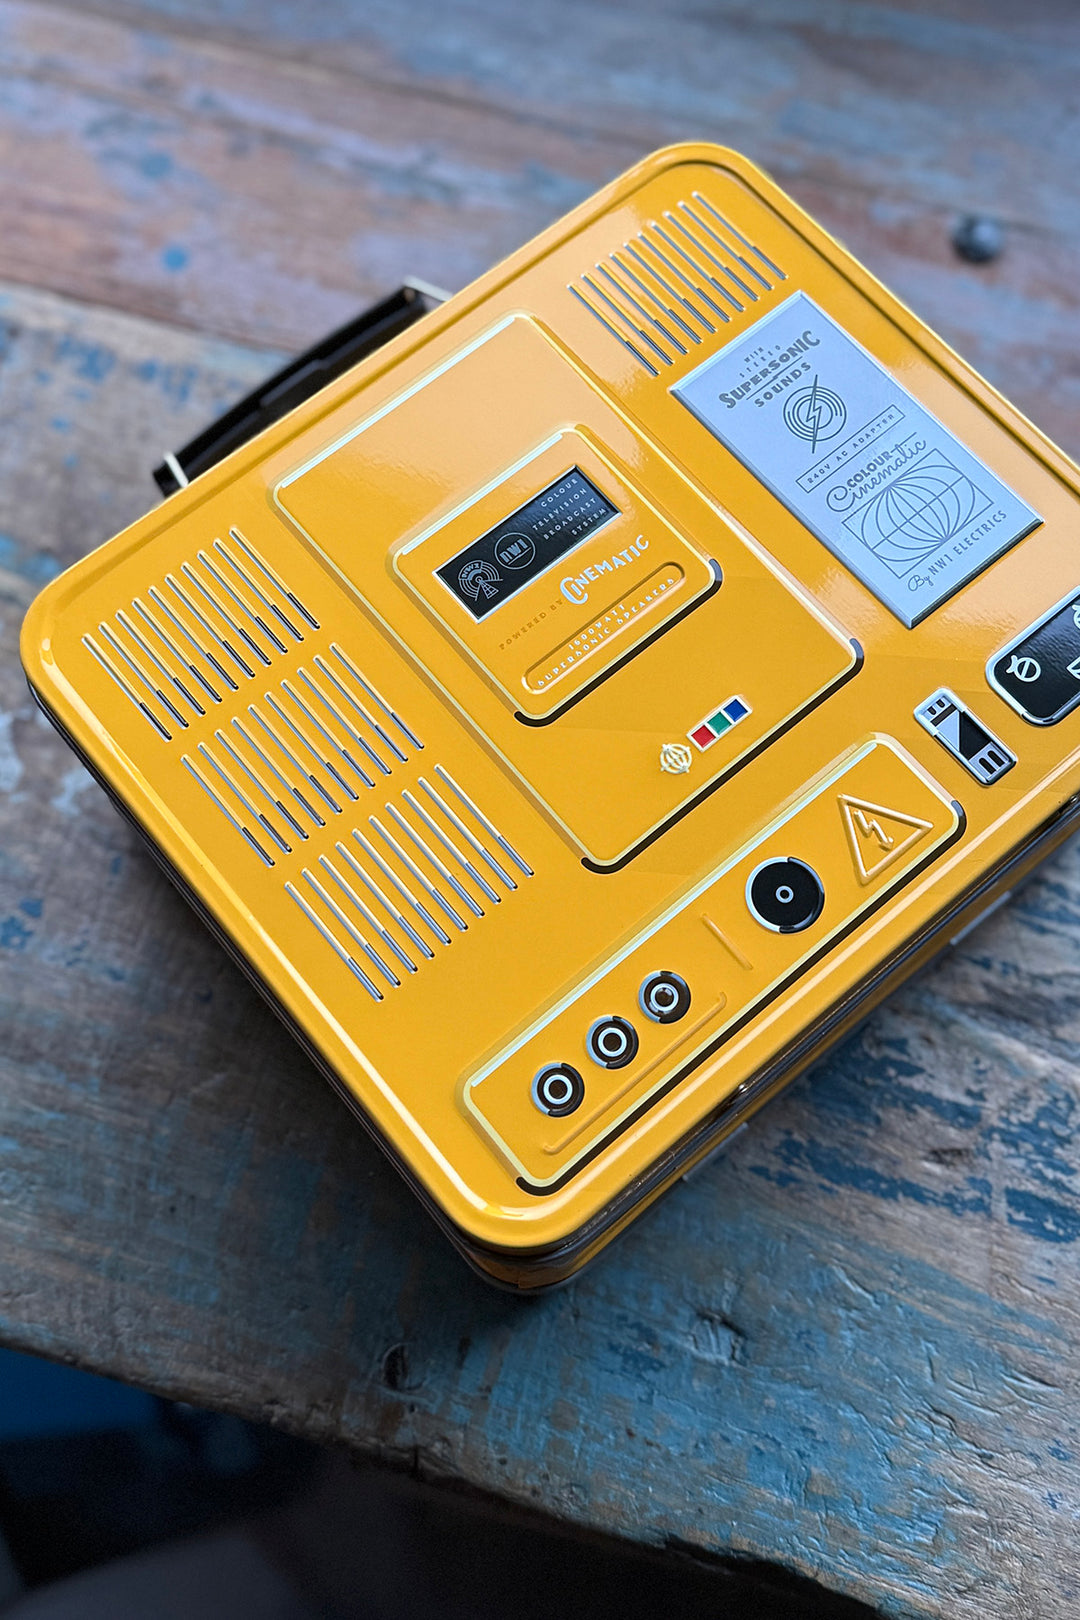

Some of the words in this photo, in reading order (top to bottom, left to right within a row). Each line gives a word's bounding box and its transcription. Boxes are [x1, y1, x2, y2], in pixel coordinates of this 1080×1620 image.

[718, 330, 821, 409] SUPERSONIC
[754, 362, 811, 408] SOUNDS
[835, 450, 848, 462] AC
[852, 414, 895, 449] ADAPTER
[826, 432, 927, 512] Cinematic
[846, 450, 893, 488] COLOUR
[532, 488, 587, 531] TELEVISION
[540, 478, 578, 508] COLOUR
[543, 497, 597, 541] BROADCAST
[571, 508, 607, 536] SYSTEM
[907, 574, 934, 592] By
[927, 553, 953, 576] NW1
[952, 510, 1007, 555] ELECTRICS
[498, 611, 547, 651] POWERED
[560, 534, 649, 605] CINEMATIC
[537, 628, 611, 687] SUPERSONIC
[616, 578, 674, 625] SPEAKERS
